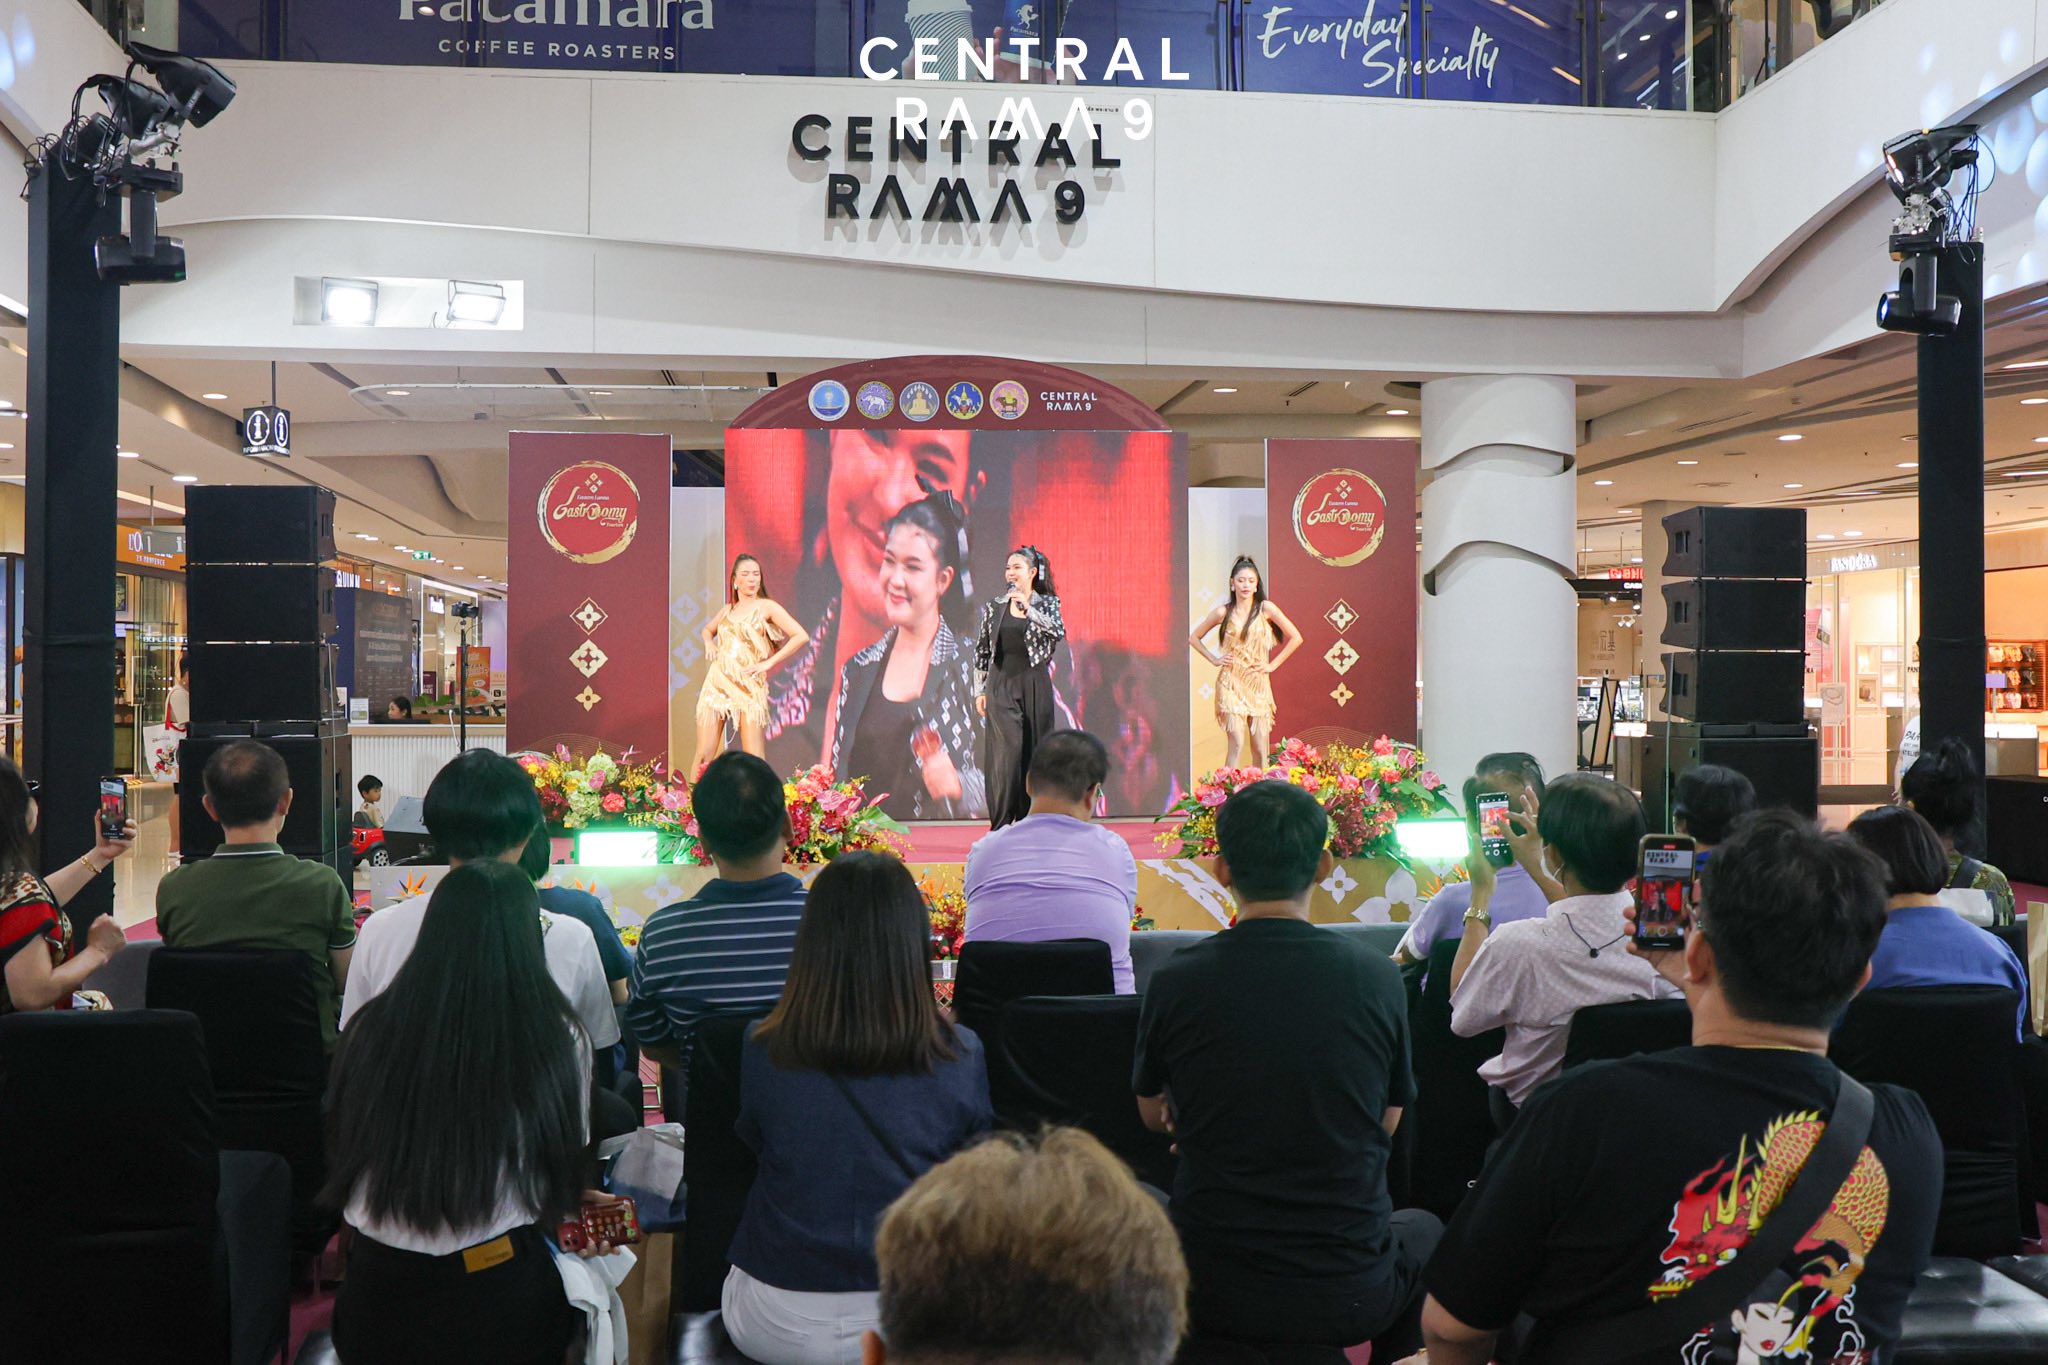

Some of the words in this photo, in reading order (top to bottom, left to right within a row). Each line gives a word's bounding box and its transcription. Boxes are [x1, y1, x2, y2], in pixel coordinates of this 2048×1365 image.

[438, 40, 535, 55] COFFEE
[548, 44, 676, 60] ROASTERS
[1257, 0, 1407, 60] Everyday
[1362, 26, 1499, 95] Specialty
[792, 113, 1121, 168] CENTRAL
[1054, 180, 1086, 224] 9
[1040, 391, 1098, 401] CENTRAL
[1085, 402, 1092, 411] 9
